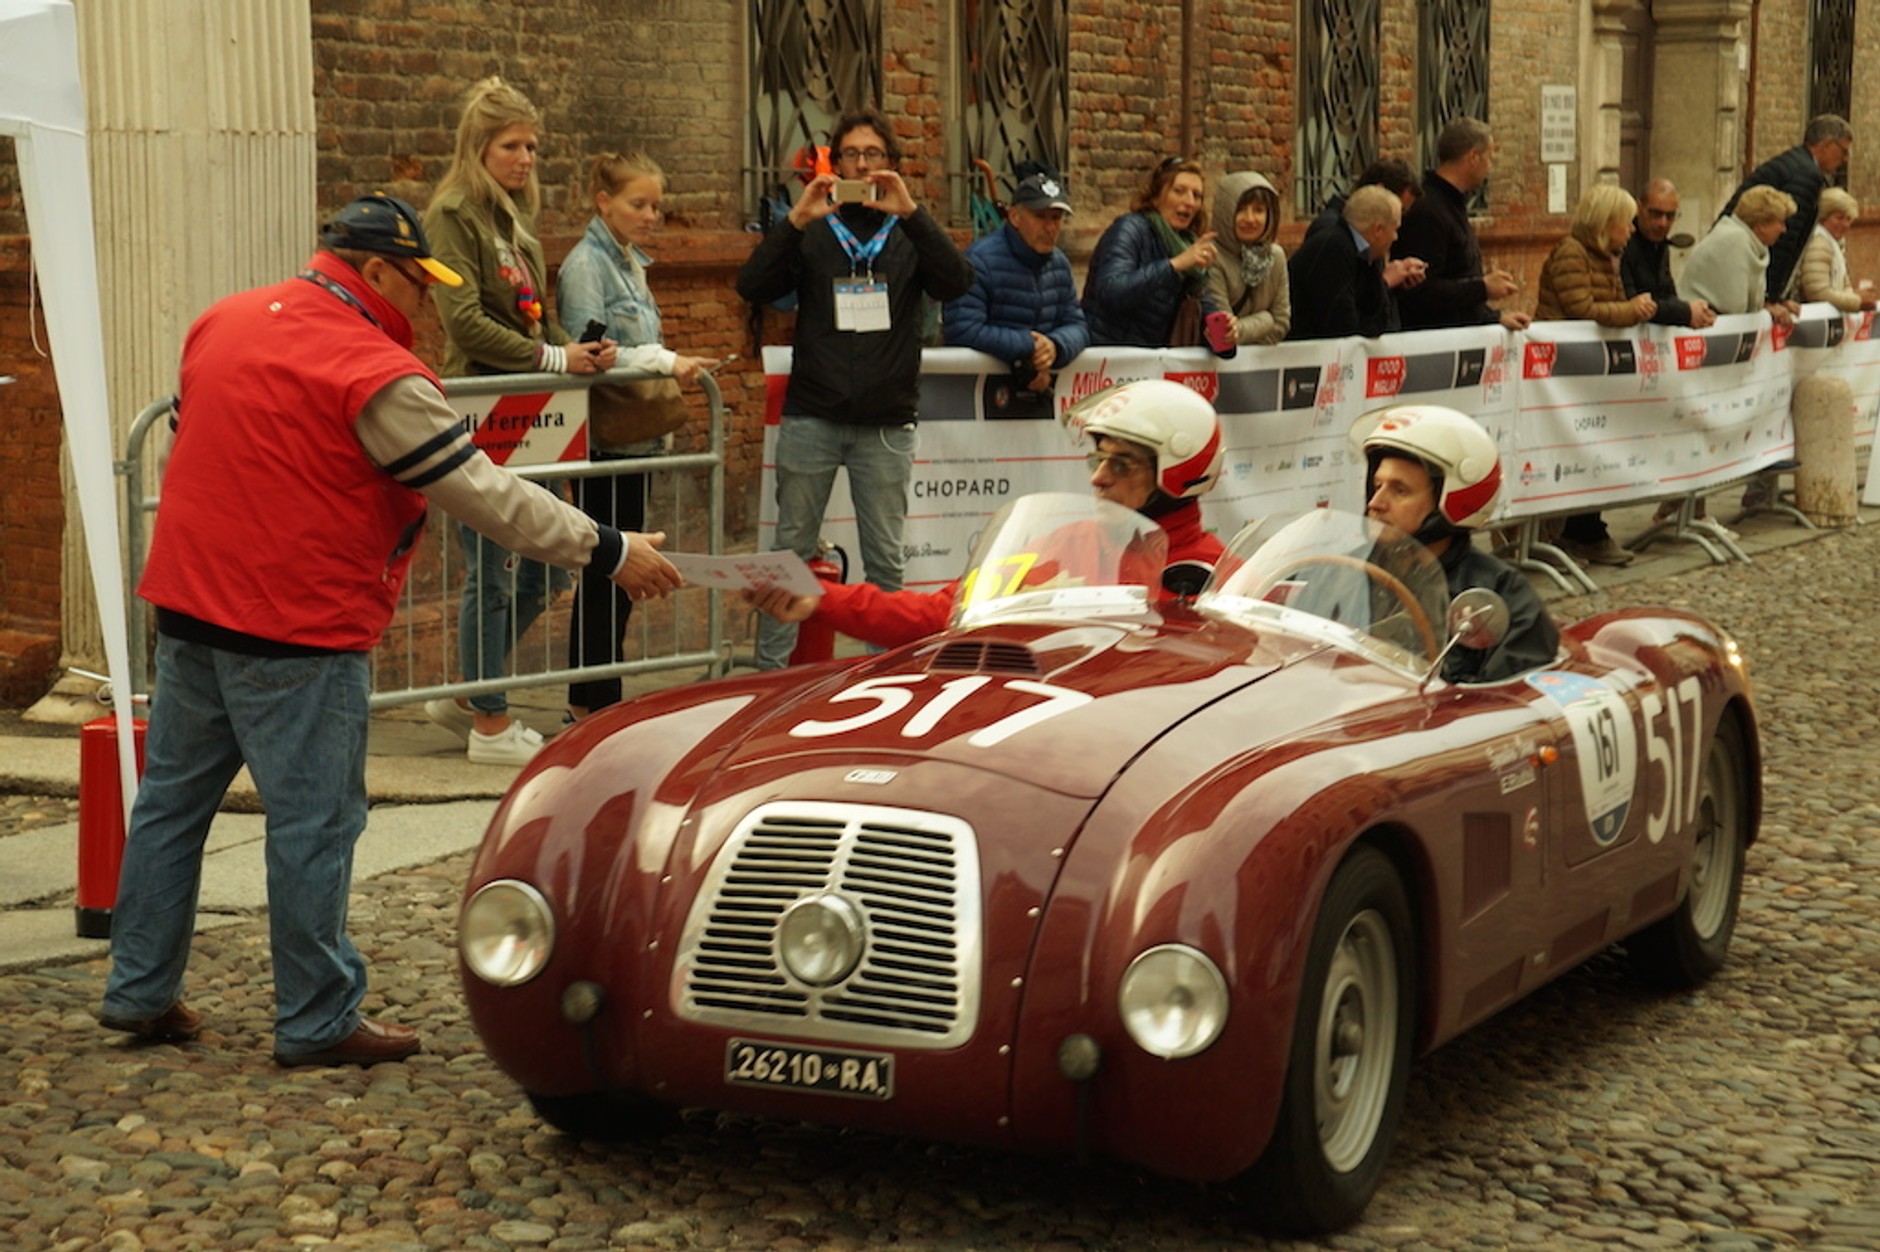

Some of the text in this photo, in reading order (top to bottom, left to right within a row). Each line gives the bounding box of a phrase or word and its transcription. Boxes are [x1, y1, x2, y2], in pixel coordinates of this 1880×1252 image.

[1376, 360, 1400, 374] 1000
[487, 411, 564, 431] Ferrara
[914, 479, 1010, 498] CHOPARD
[788, 673, 1094, 747] 517
[1587, 706, 1620, 782] 167
[1641, 675, 1703, 844] 517
[737, 1045, 880, 1093] 26210 RA
